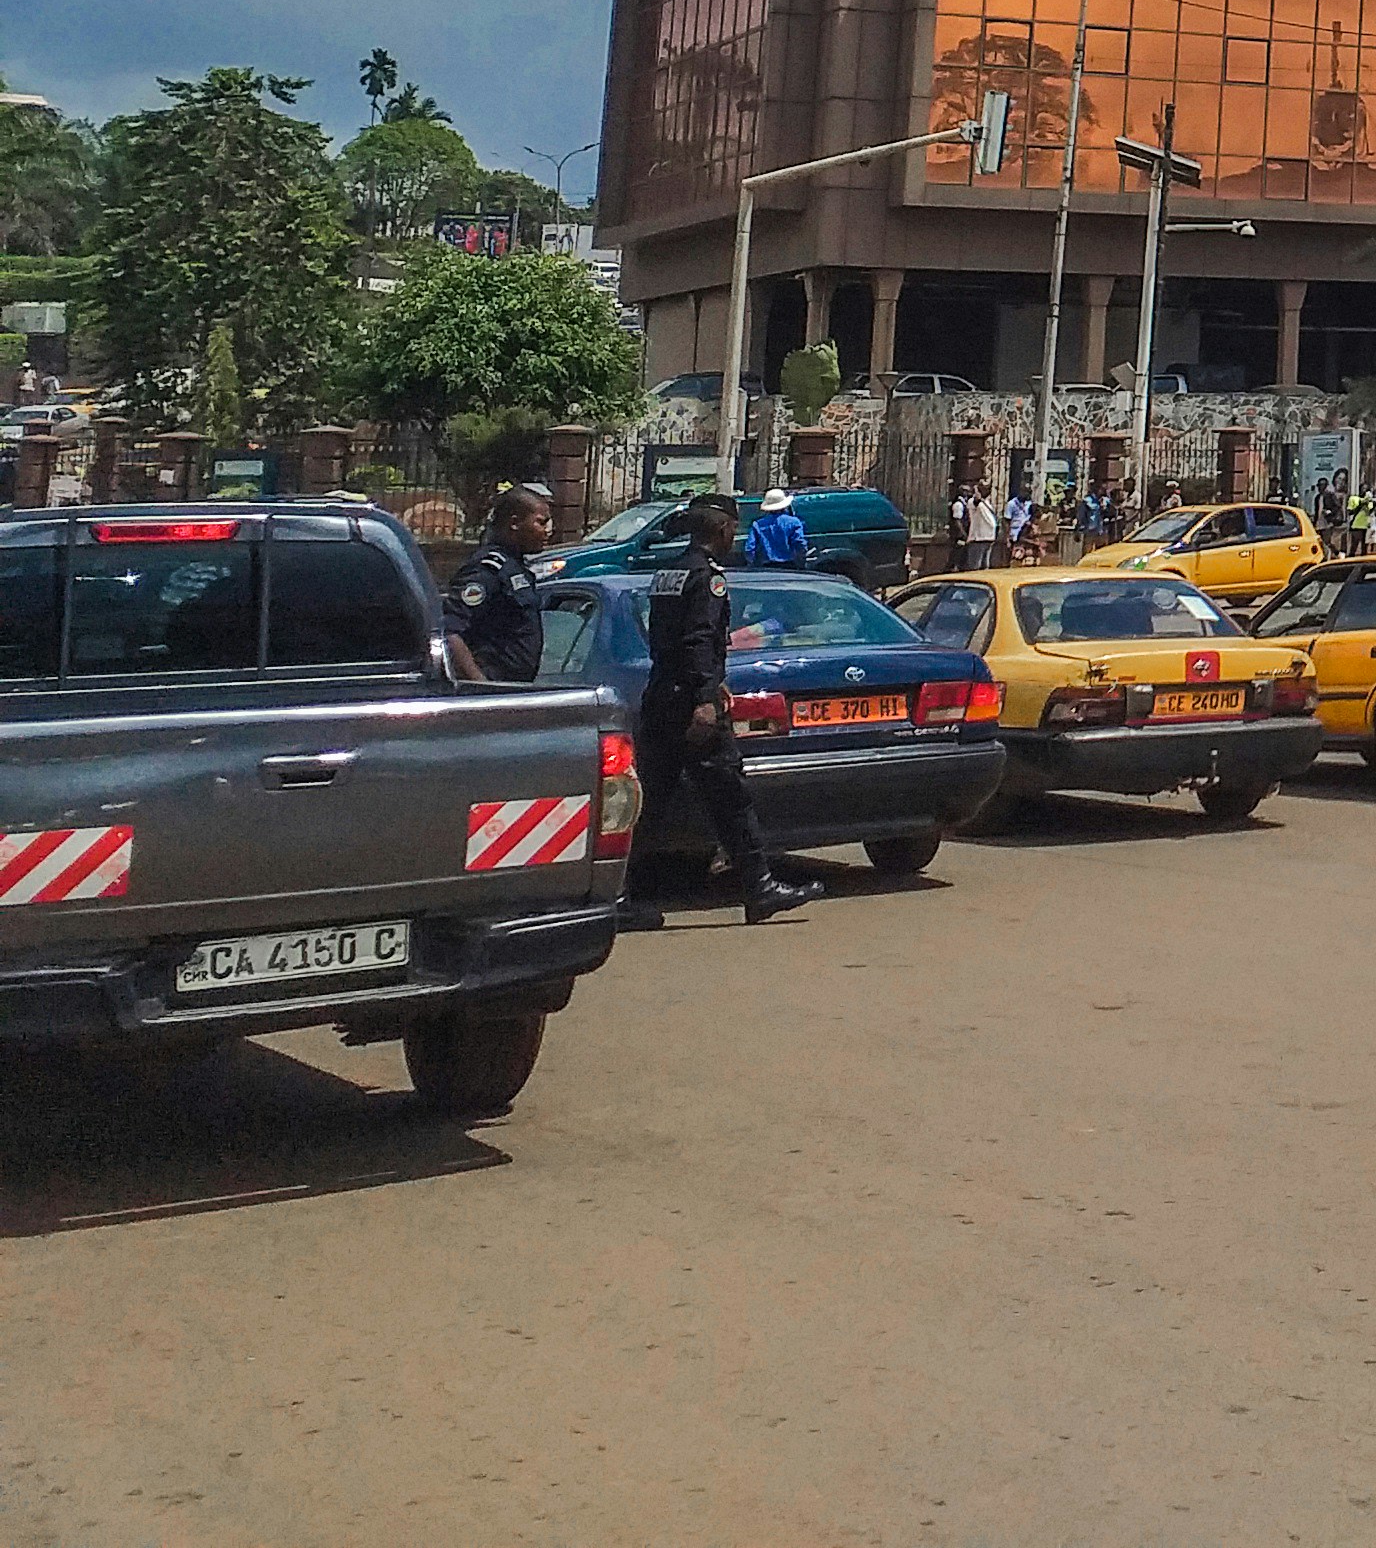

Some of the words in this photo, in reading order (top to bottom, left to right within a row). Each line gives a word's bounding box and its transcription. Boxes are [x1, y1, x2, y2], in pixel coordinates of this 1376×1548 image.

[810, 702, 831, 722] CE
[841, 699, 870, 720] 370
[1168, 695, 1185, 712] CE
[1191, 693, 1219, 711] 240
[210, 946, 254, 980] CA
[267, 932, 357, 973] 4150
[374, 928, 396, 960] C
[183, 970, 209, 984] CMR
